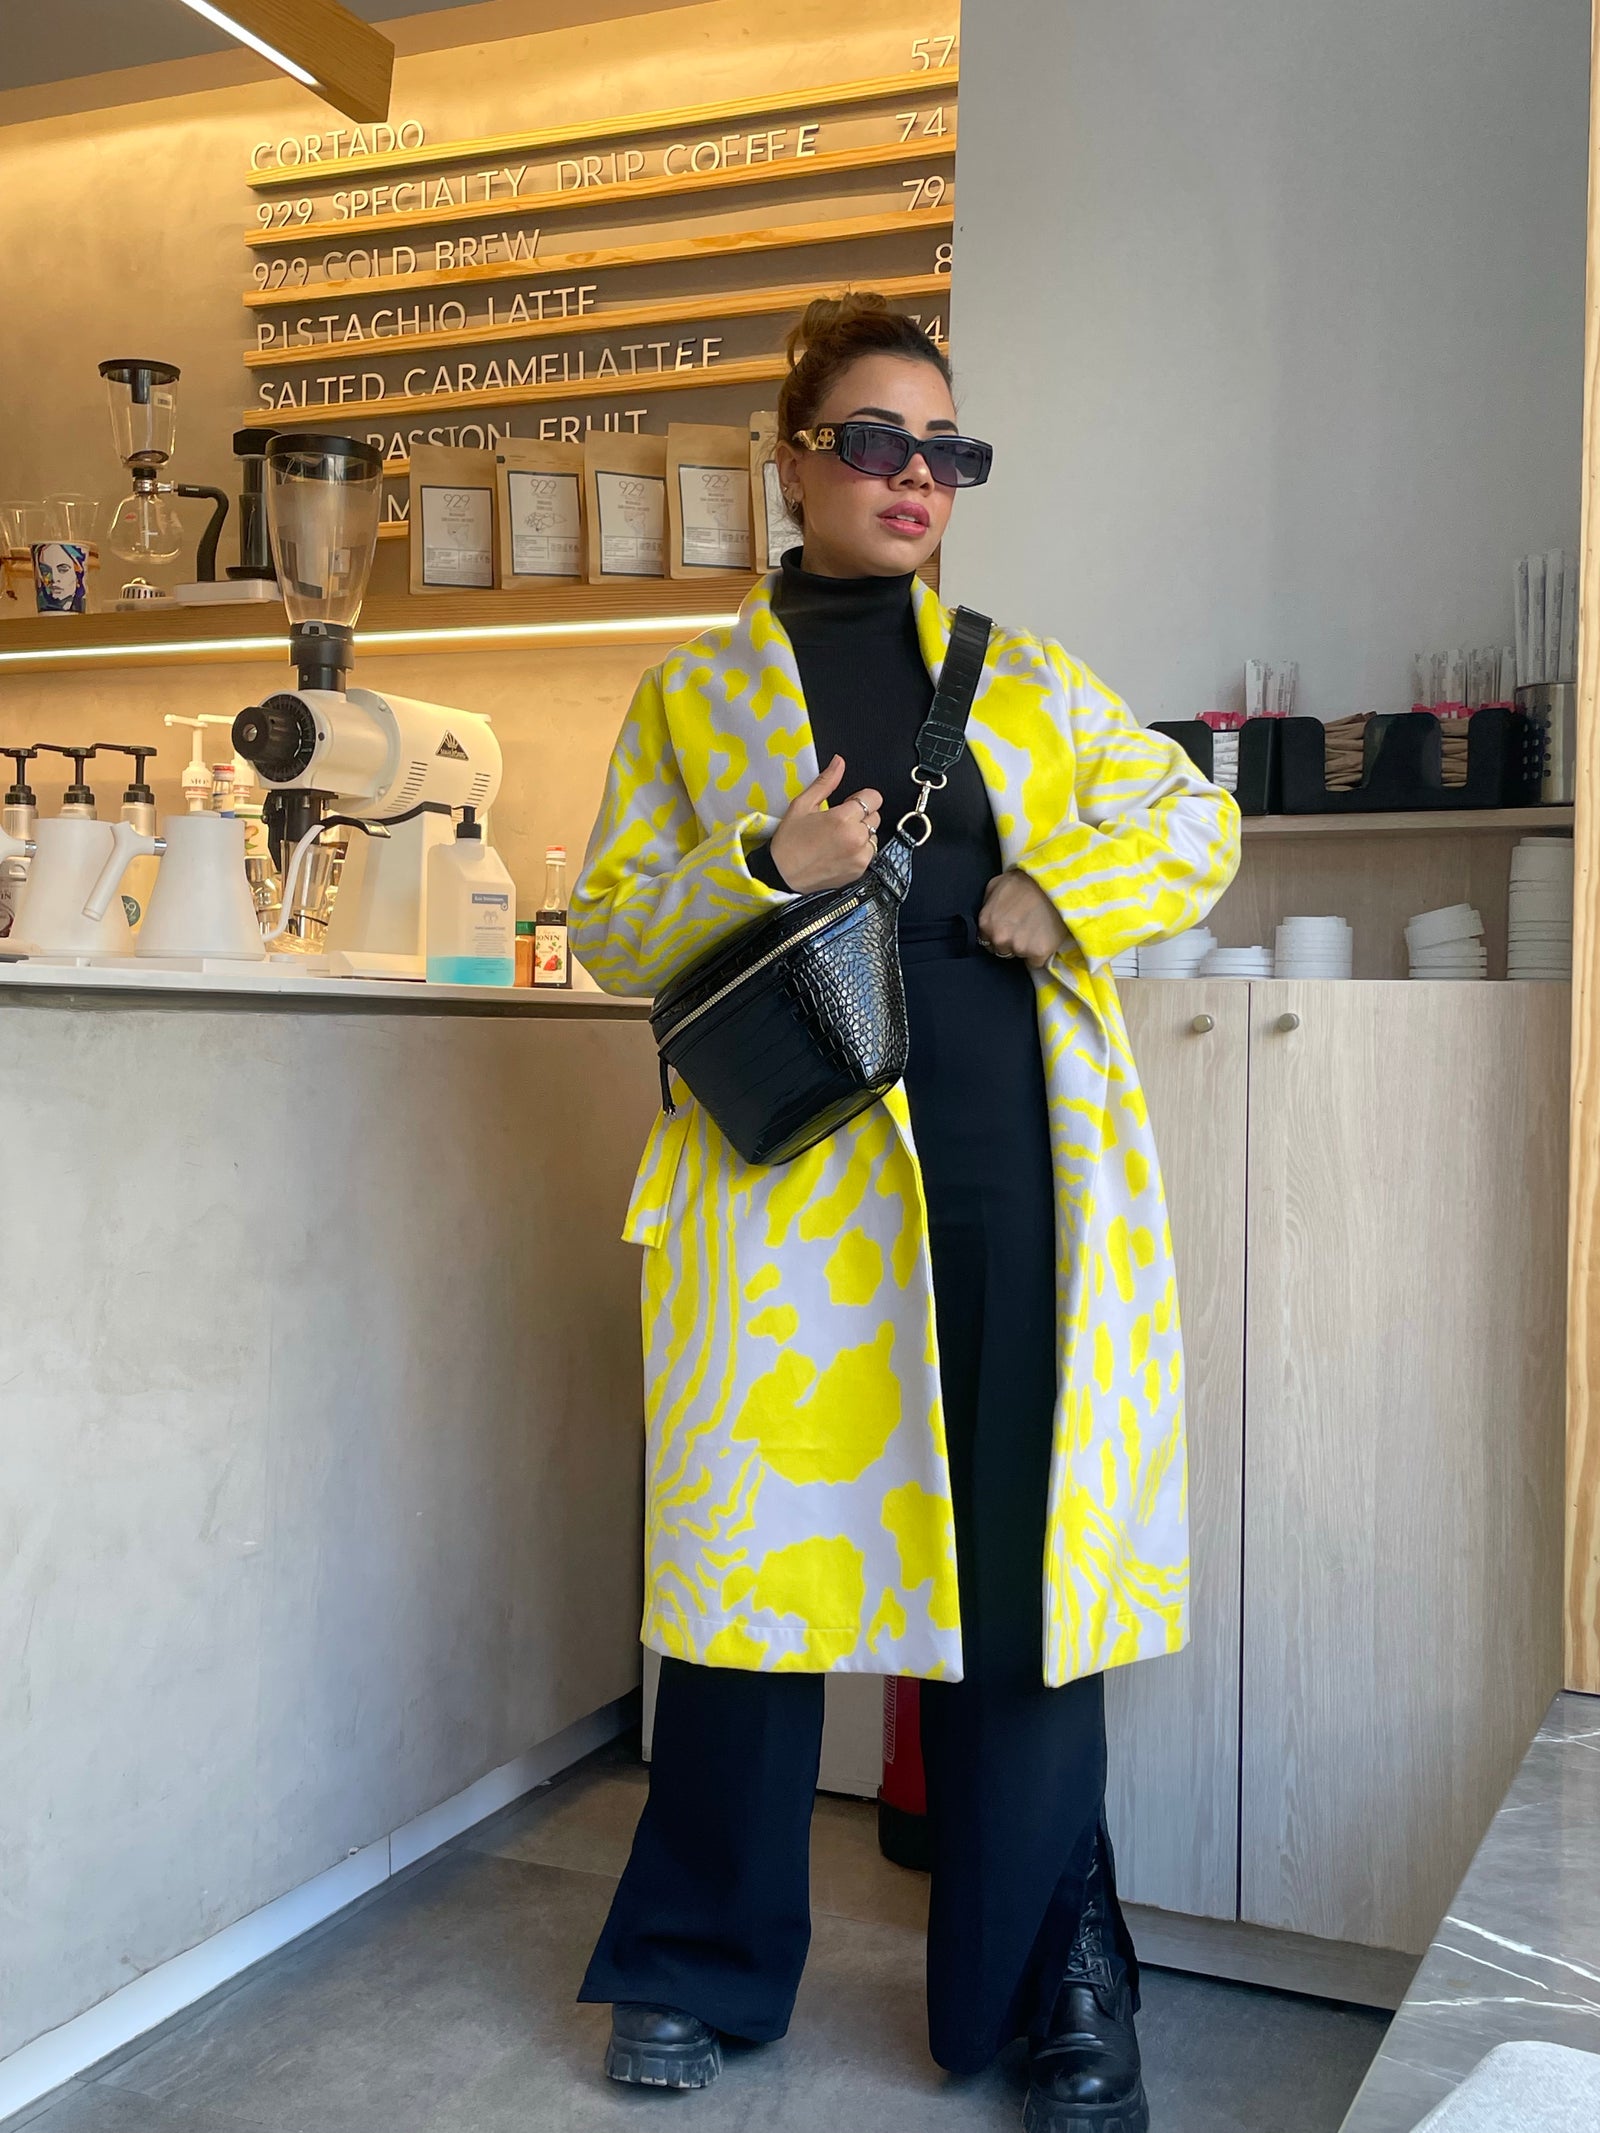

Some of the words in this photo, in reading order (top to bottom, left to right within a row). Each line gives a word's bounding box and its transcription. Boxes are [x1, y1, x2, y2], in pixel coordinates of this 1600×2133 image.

[250, 119, 425, 170] CORTADO
[910, 35, 956, 72] 57
[256, 198, 314, 229] 929
[332, 165, 528, 222] SPECIALTY
[556, 150, 645, 191] DRIP
[896, 107, 947, 143] 74
[252, 257, 310, 290] 929
[322, 246, 417, 281] COLD
[434, 228, 541, 271] BREW
[902, 175, 945, 211] 79
[257, 301, 467, 351] PISTACHIO
[488, 285, 598, 326] LATTE
[259, 372, 385, 411] SALTED
[443, 493, 470, 508] 929
[531, 479, 557, 494] 929
[619, 481, 645, 496] 929
[702, 474, 729, 488] 929
